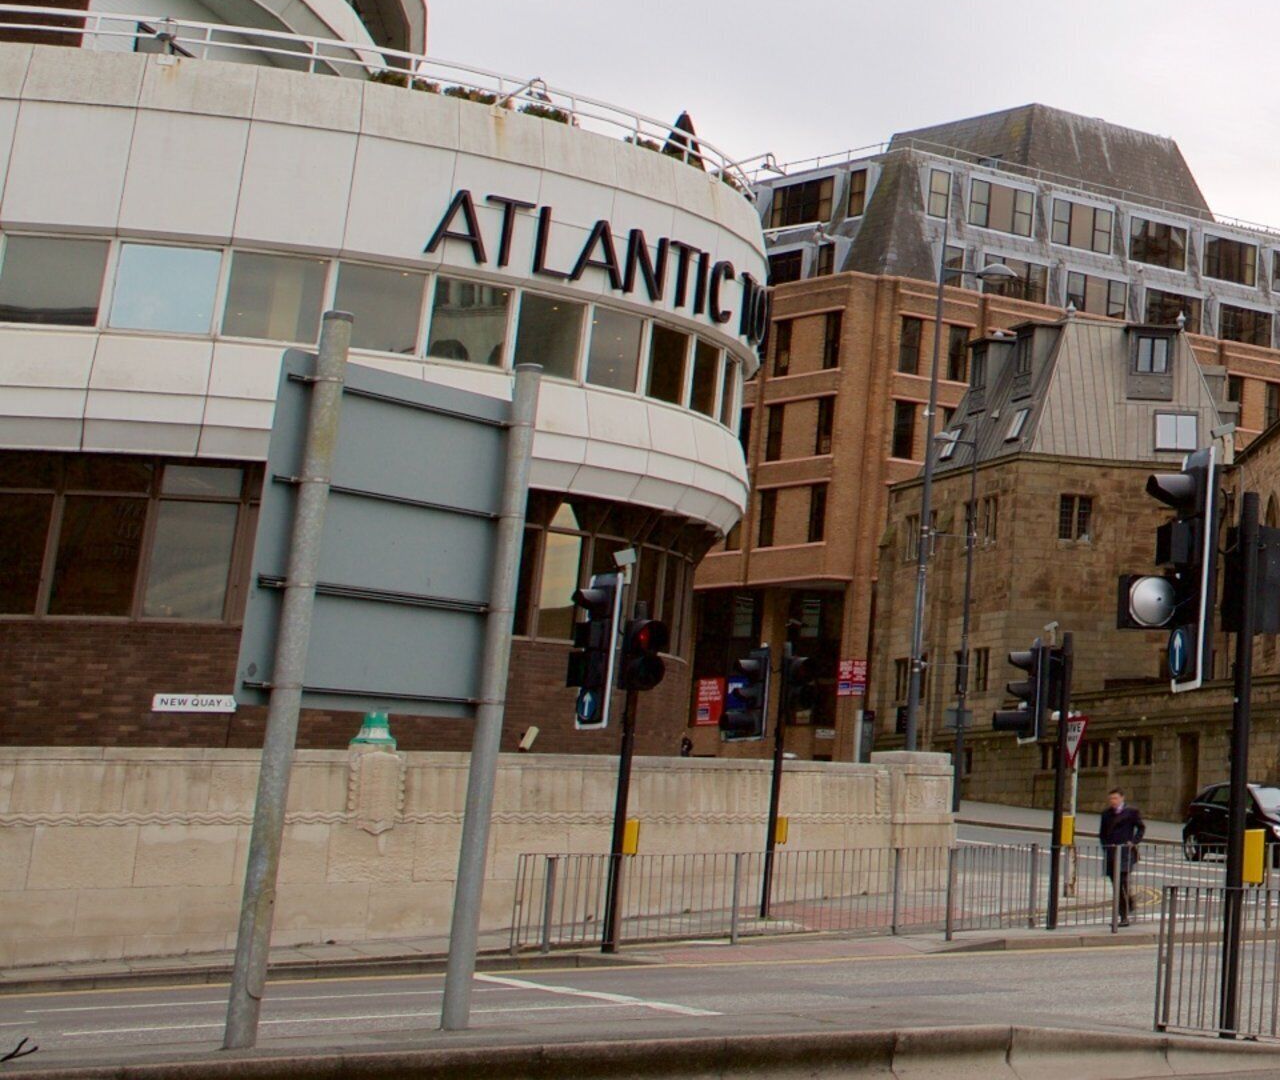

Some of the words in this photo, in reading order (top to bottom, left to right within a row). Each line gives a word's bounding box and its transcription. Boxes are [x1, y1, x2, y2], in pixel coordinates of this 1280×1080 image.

[424, 189, 737, 324] ATLANTIC
[160, 698, 188, 707] NEW
[191, 699, 223, 708] QUAY
